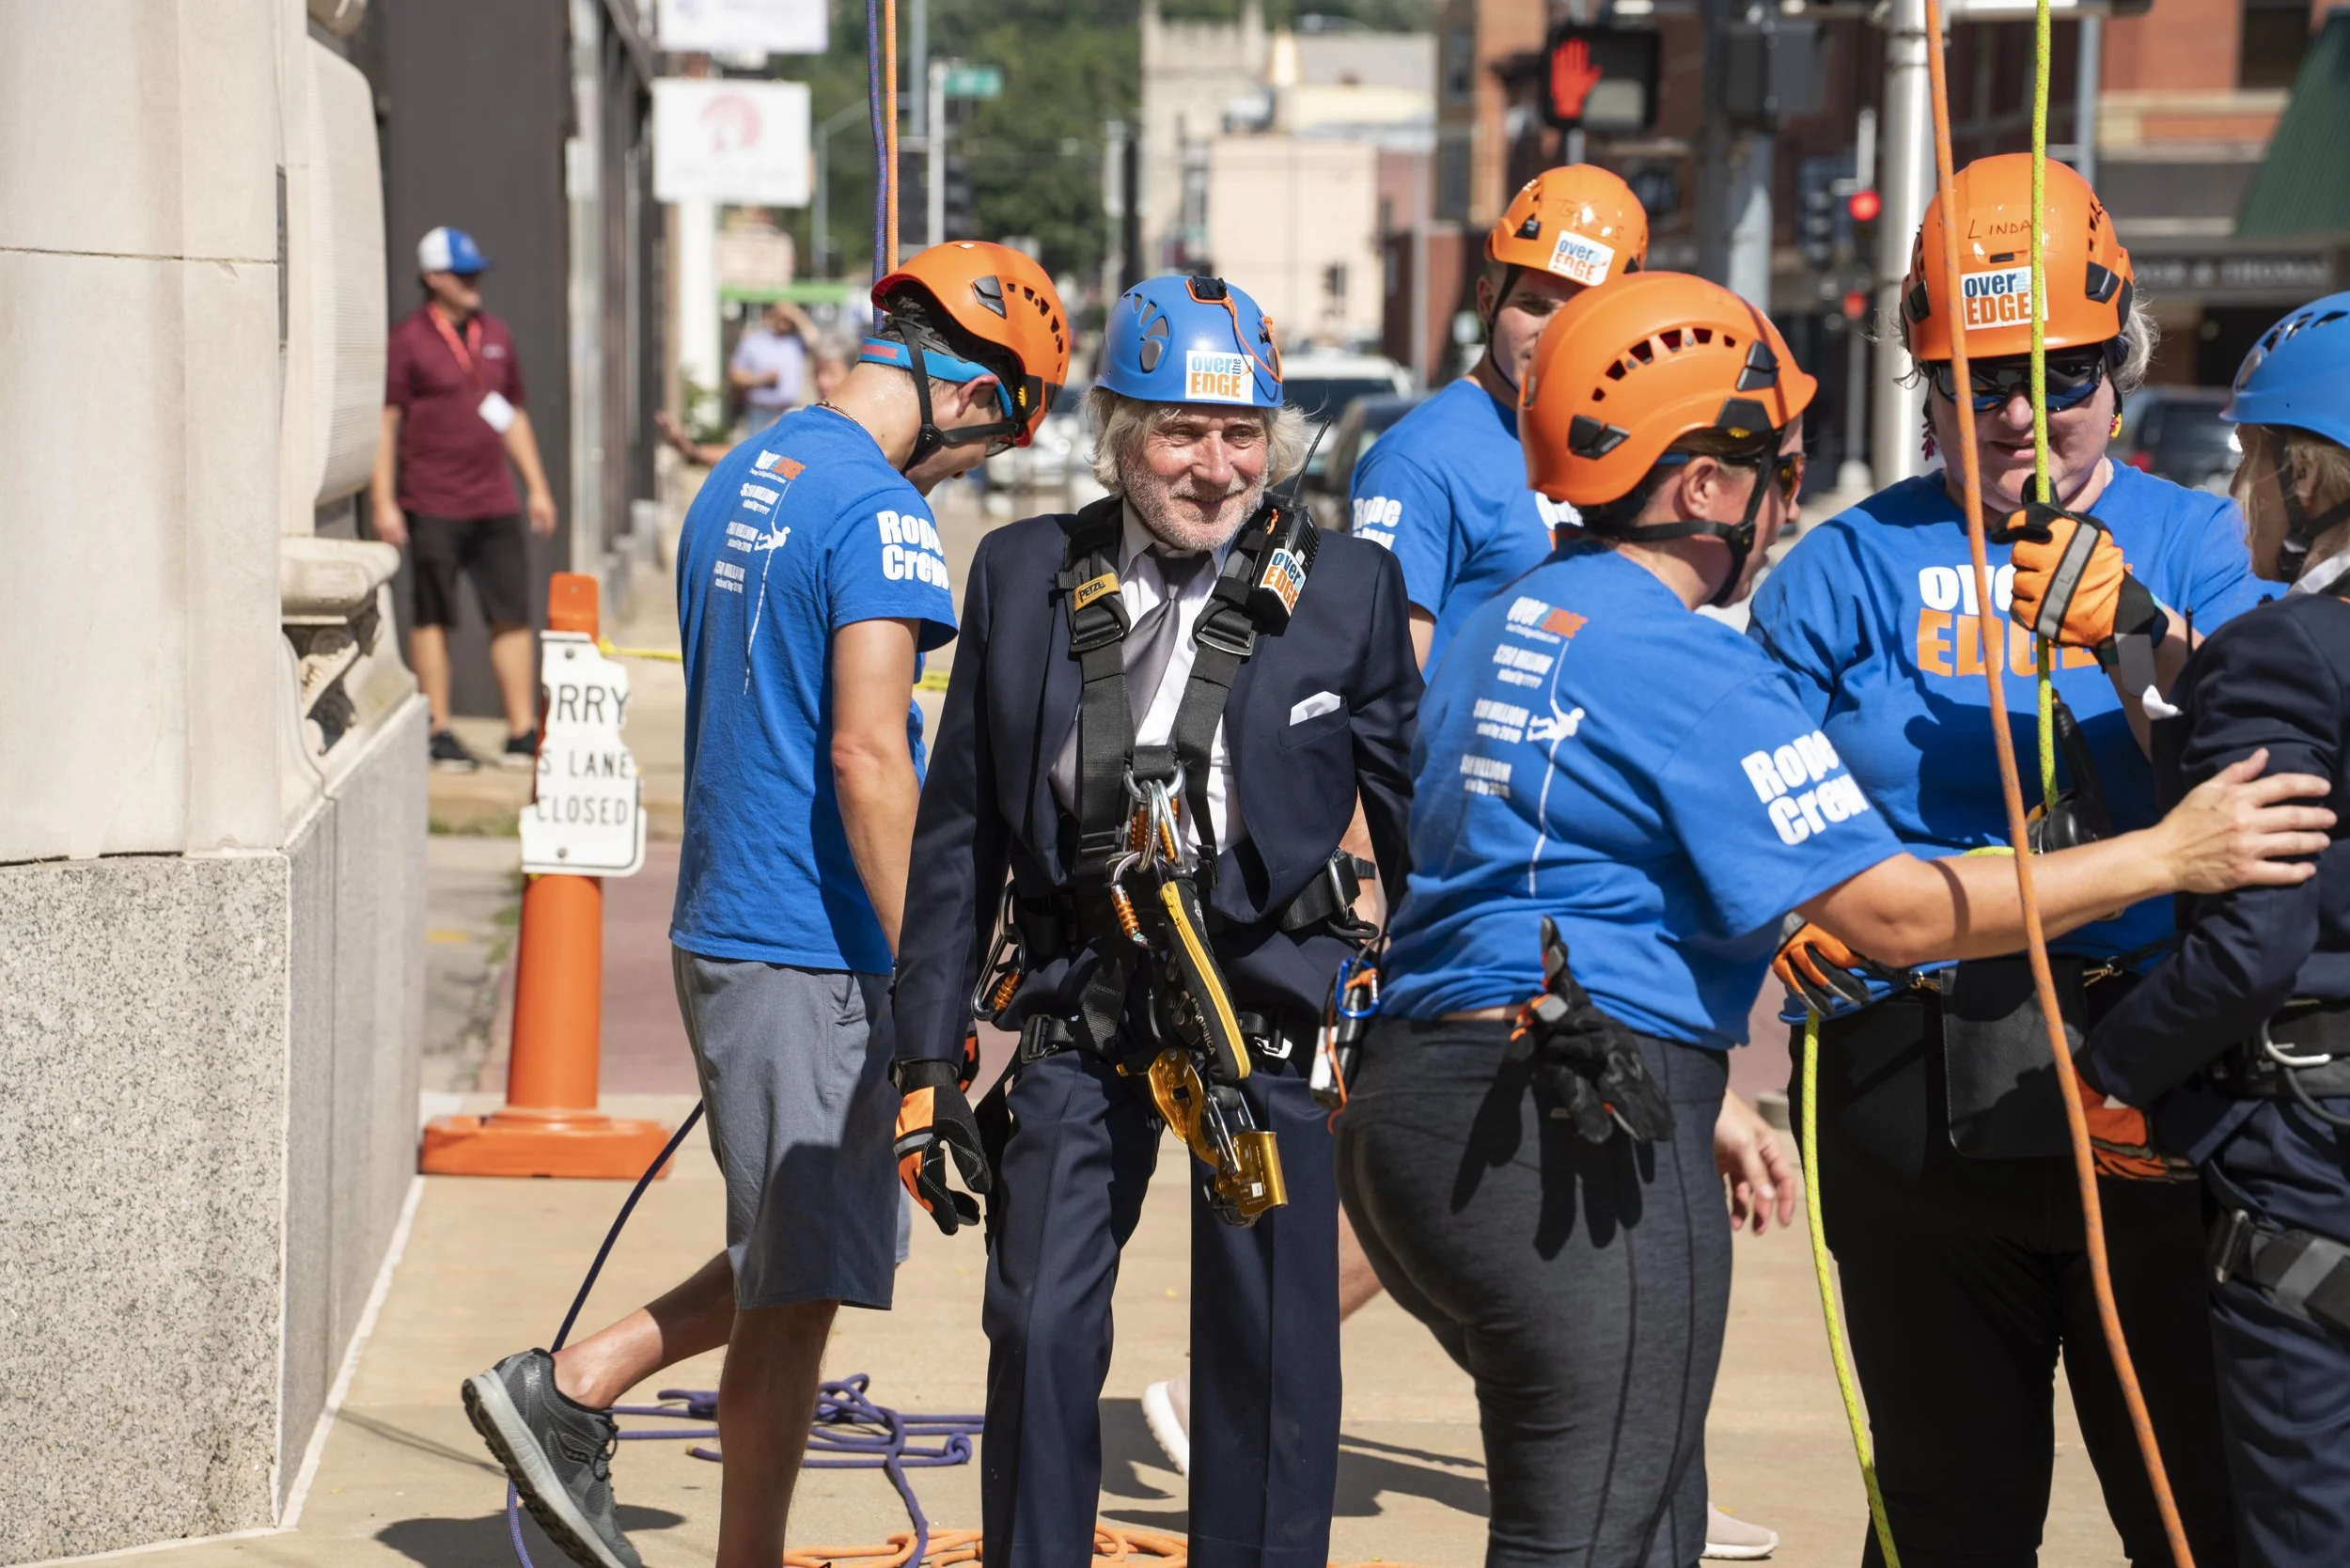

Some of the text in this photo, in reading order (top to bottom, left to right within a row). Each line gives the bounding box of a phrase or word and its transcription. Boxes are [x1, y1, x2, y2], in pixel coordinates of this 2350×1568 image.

[1967, 218, 2032, 240] LINDA
[1559, 240, 1595, 261] over
[1553, 252, 1596, 281] EDGE
[1964, 273, 2016, 298] over
[1966, 292, 2032, 325] EDGE
[1191, 356, 1232, 374] over
[1231, 358, 1242, 375] the
[1190, 372, 1241, 398] EDGE
[1353, 496, 1402, 527] Rope
[876, 510, 944, 557] Rope
[882, 544, 949, 590] Crew
[1272, 552, 1302, 585] over
[1078, 581, 1106, 603] PETZL
[1262, 566, 1298, 612] EDGE
[569, 749, 633, 779] LANE
[1740, 729, 1840, 804] Rope
[537, 794, 628, 825] CLOSED
[1768, 774, 1870, 845] Crew
